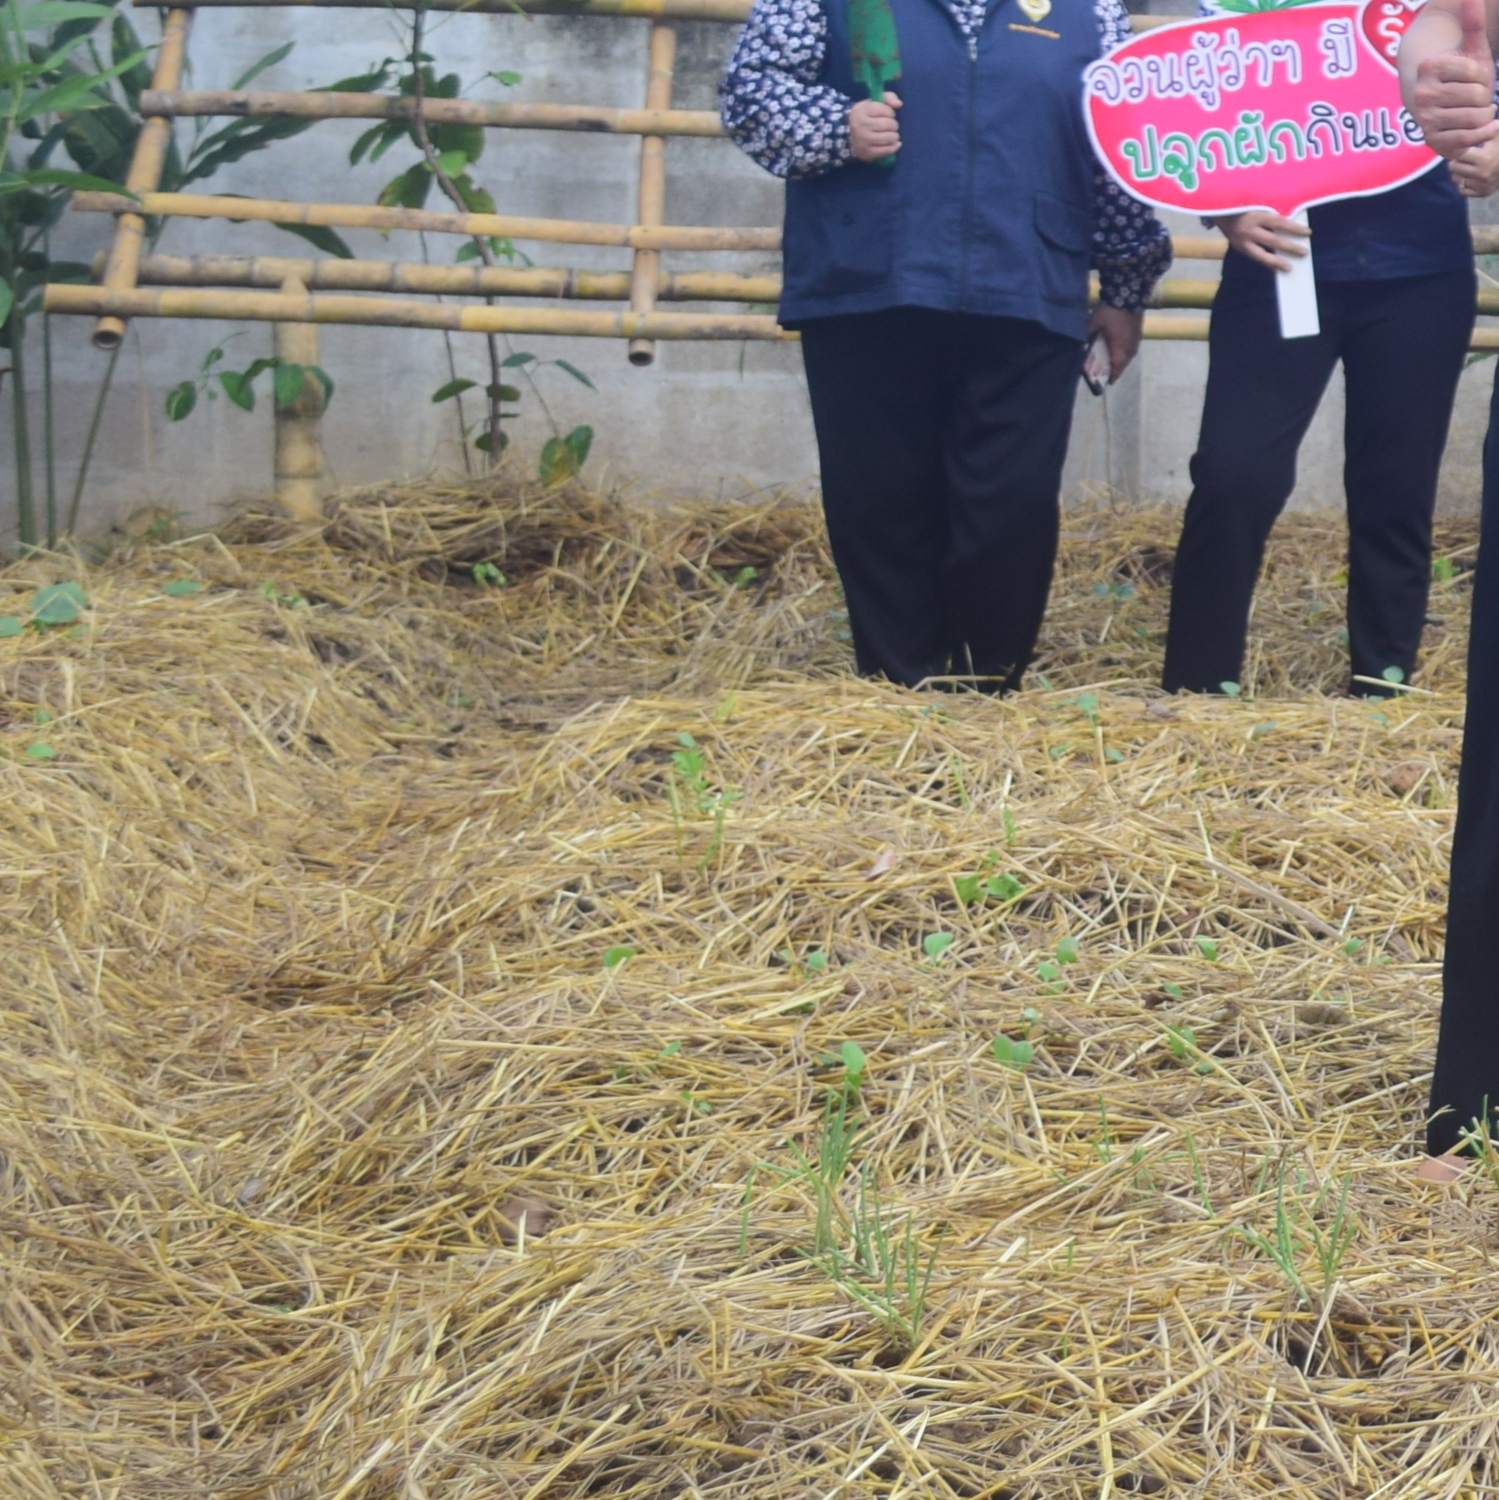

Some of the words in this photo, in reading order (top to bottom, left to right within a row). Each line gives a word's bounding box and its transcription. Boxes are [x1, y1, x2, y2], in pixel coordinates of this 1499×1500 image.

[1087, 31, 1300, 108] จวนผู้ว่าฯ
[1323, 20, 1353, 75] มี
[1123, 103, 1426, 190] ปลูกผักกินเอ
